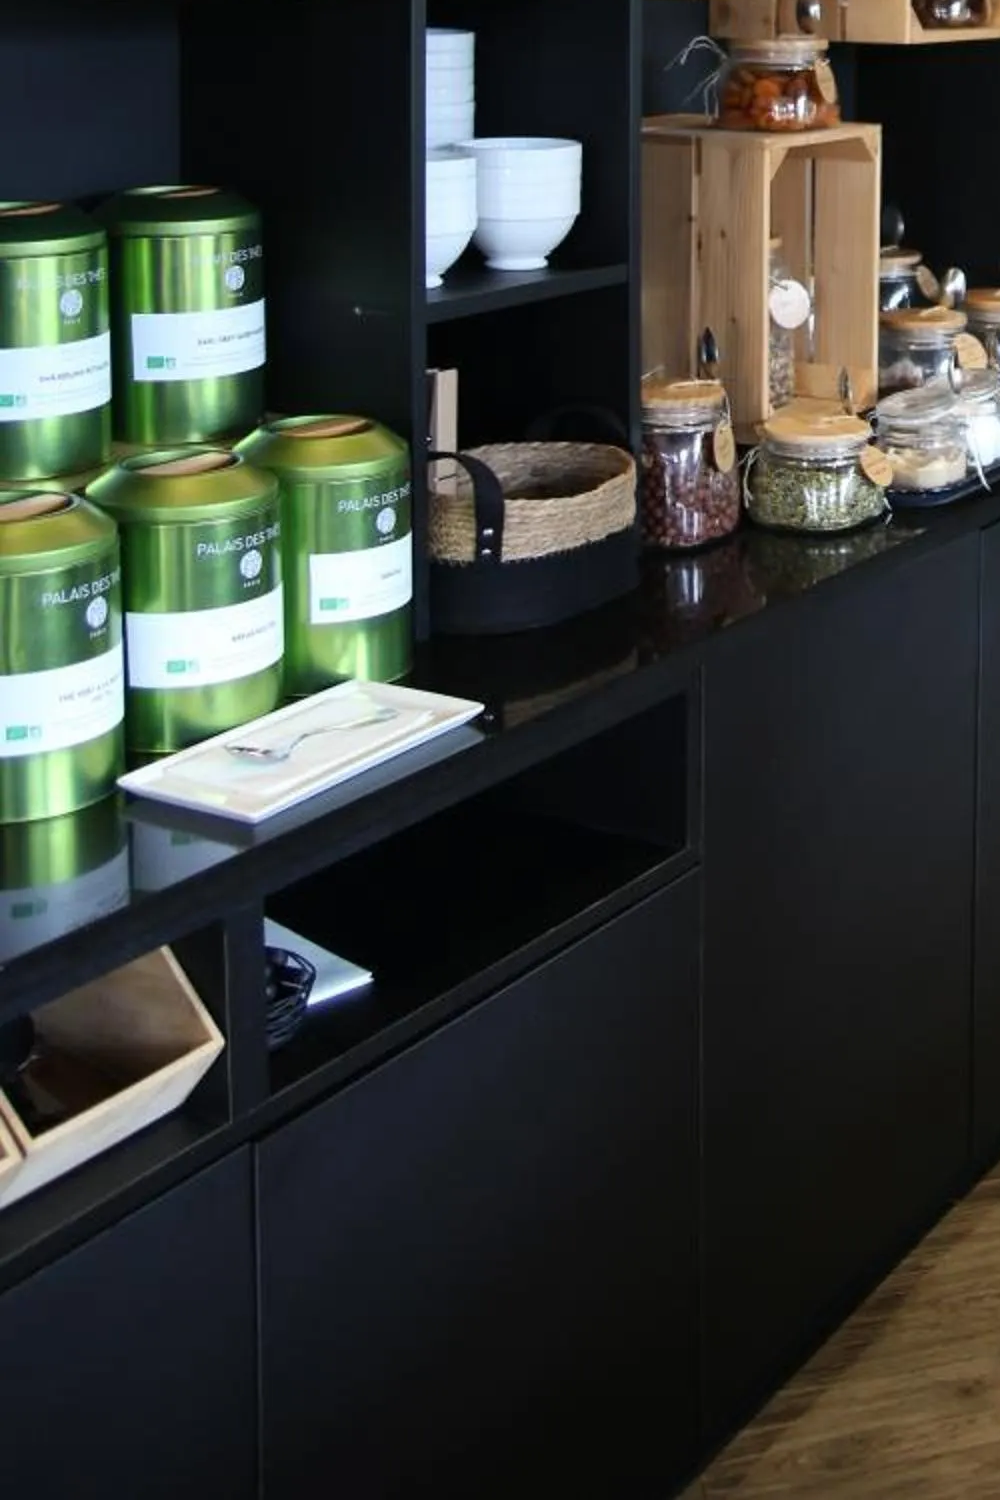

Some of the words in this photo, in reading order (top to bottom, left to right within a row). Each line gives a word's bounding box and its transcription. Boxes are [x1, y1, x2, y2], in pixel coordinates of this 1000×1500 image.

[337, 495, 380, 513] PALAIS
[381, 490, 399, 506] DES
[197, 537, 244, 556] PALAIS
[245, 531, 265, 549] DES
[41, 583, 90, 607] PALAIS
[91, 575, 110, 595] DES
